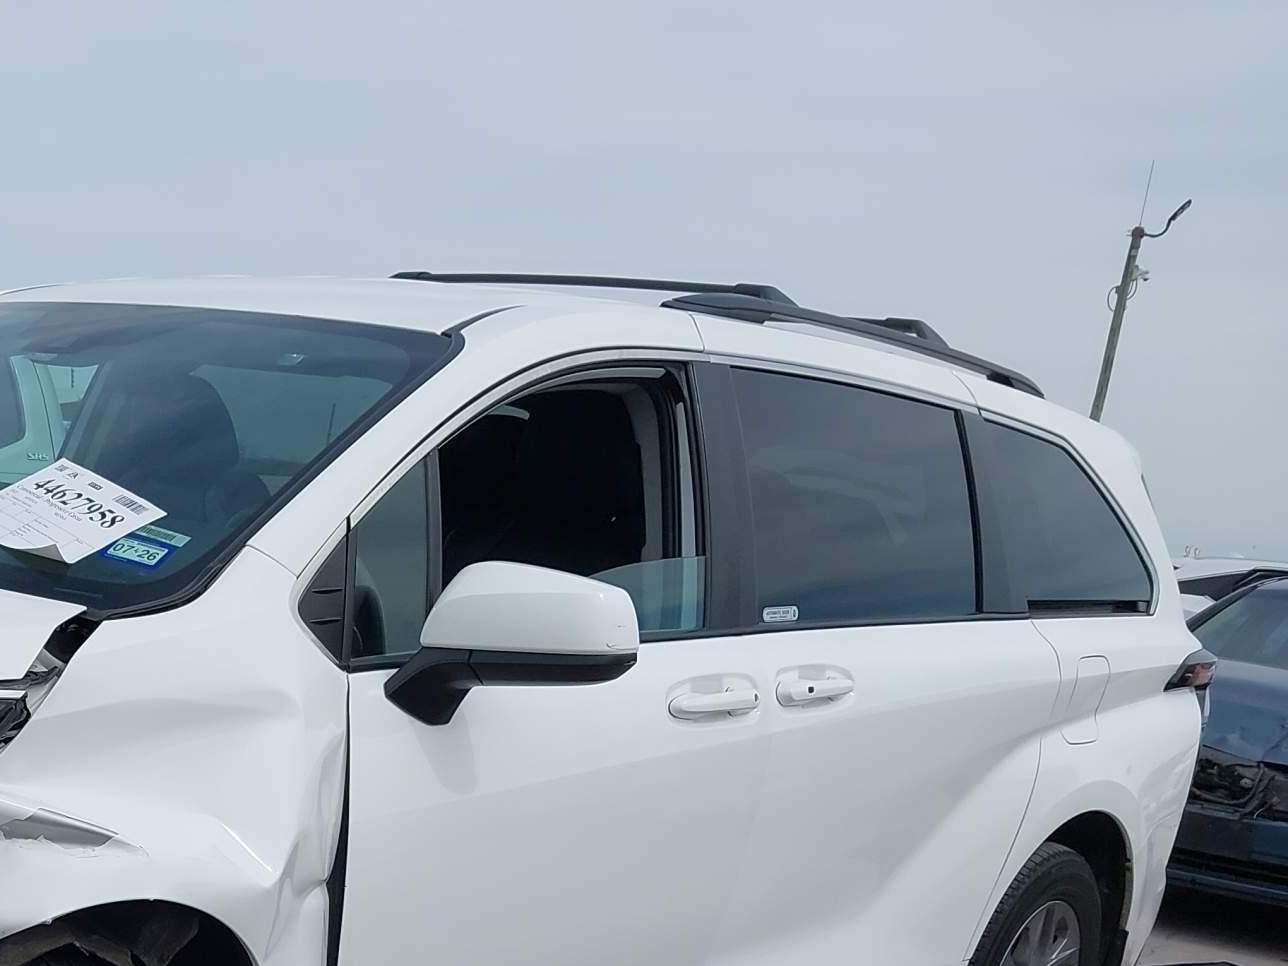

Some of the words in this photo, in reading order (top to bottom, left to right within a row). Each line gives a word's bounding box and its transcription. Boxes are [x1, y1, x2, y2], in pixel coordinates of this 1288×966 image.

[33, 478, 126, 529] 44627958
[112, 543, 135, 554] 07
[136, 549, 160, 561] 26
